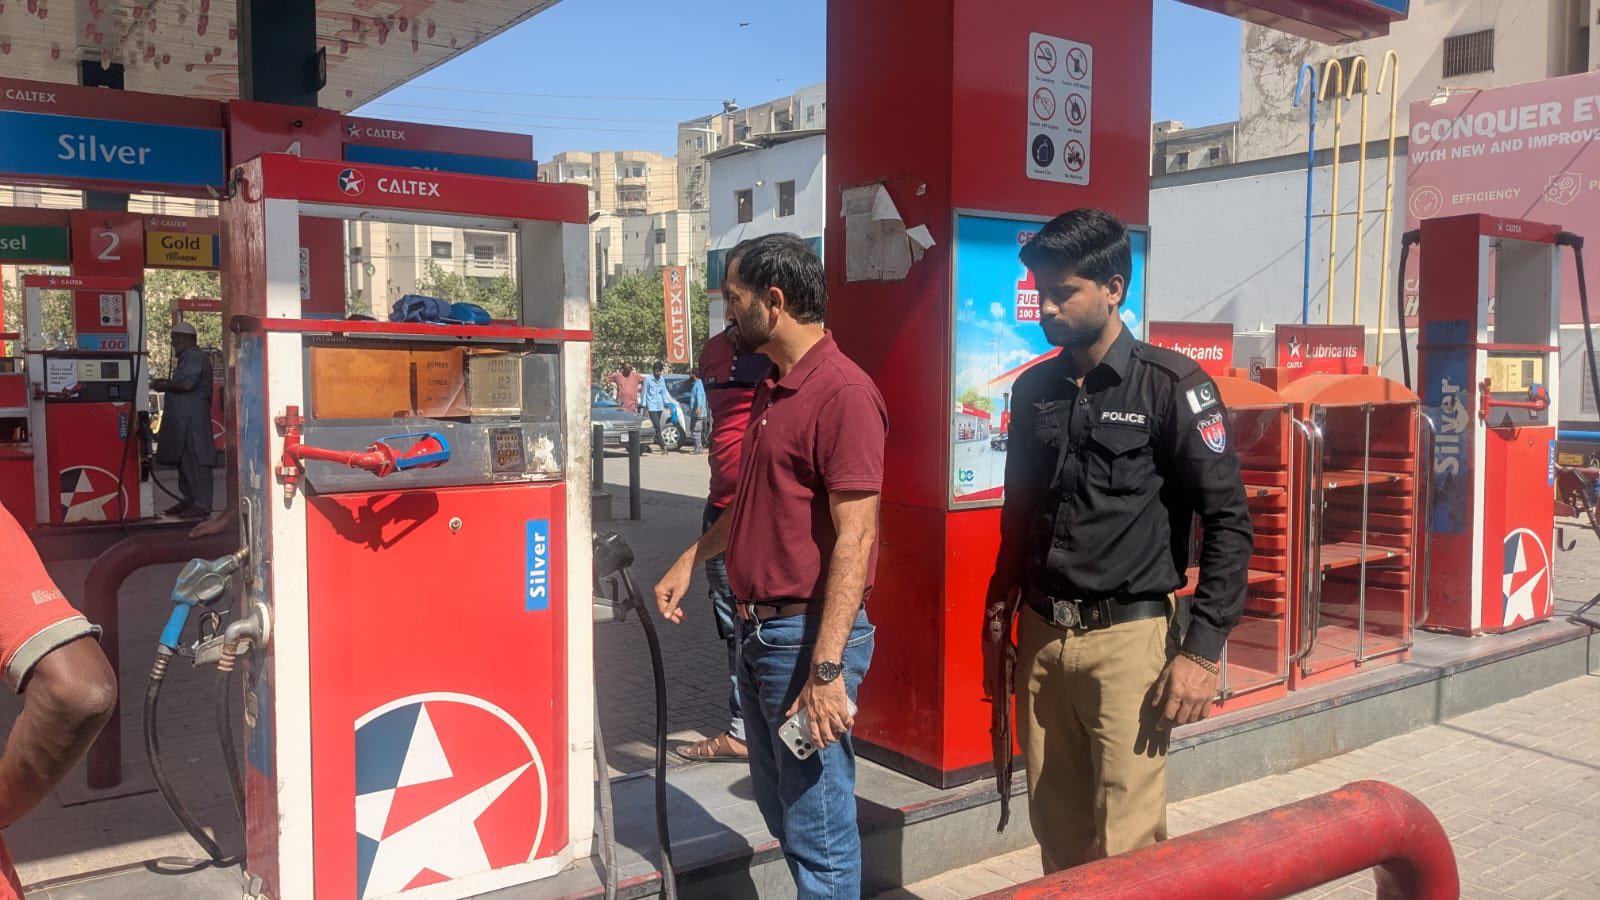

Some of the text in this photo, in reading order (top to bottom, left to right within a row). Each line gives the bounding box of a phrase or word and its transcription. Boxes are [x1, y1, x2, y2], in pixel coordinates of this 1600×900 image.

[6, 89, 56, 104] CALTEX
[1412, 101, 1563, 145] CONQUER
[366, 127, 406, 141] CALTEX
[58, 134, 151, 165] Silver
[1411, 149, 1447, 165] WITH
[1451, 143, 1486, 160] NEW
[1490, 138, 1524, 155] AND
[377, 177, 440, 198] CALTEX
[1452, 188, 1521, 205] EFFICIENCY
[160, 220, 187, 228] CALTEX
[98, 231, 121, 261] 2
[161, 236, 200, 250] Gold
[1018, 310, 1033, 318] 100
[671, 290, 684, 360] CALTEX
[101, 340, 125, 349] 100
[1305, 343, 1357, 358] Lubricants
[1101, 411, 1146, 424] POLICE
[1434, 375, 1460, 476] Silver
[529, 532, 546, 598] Silver
